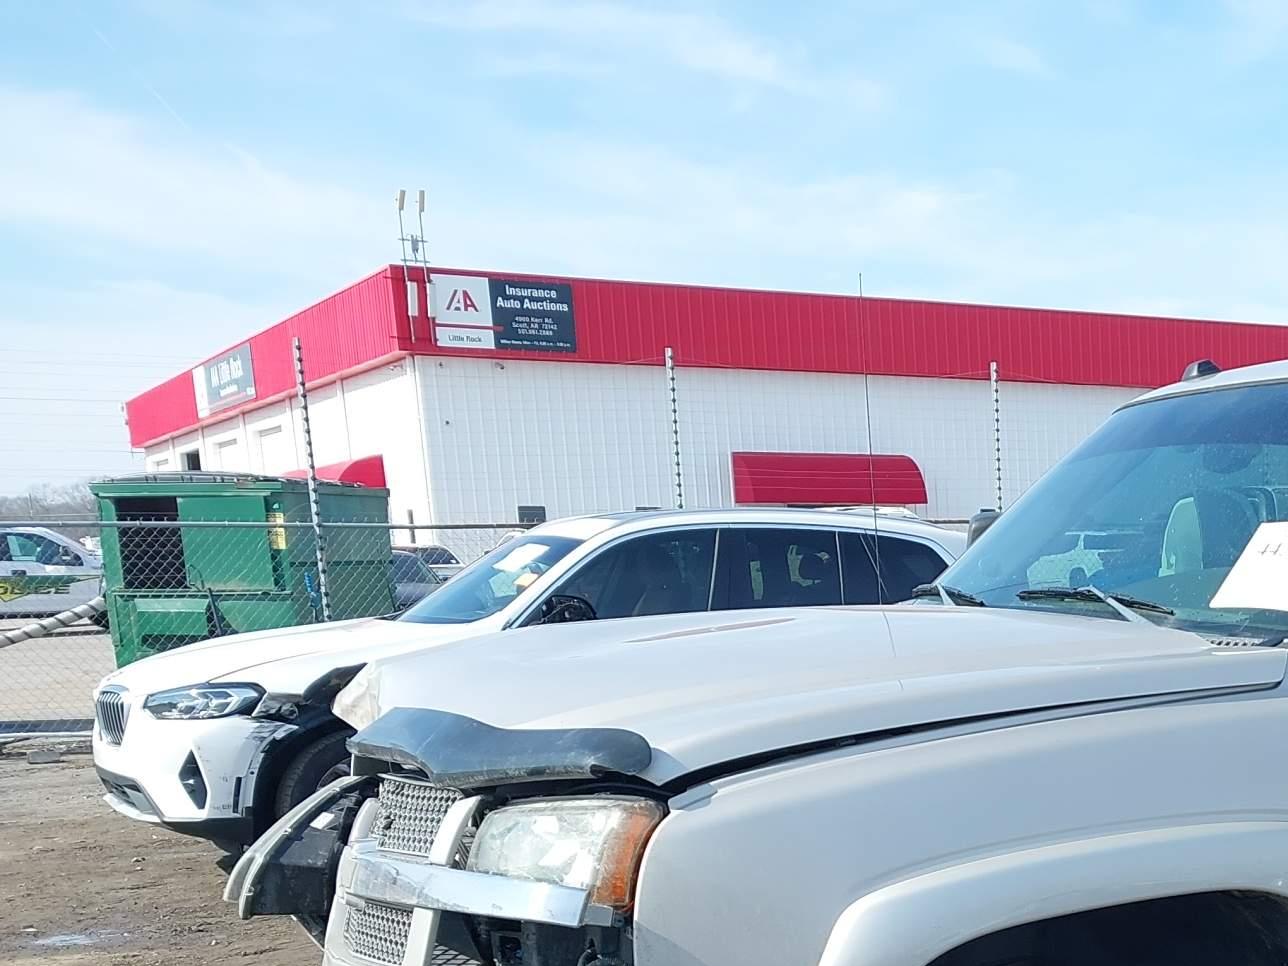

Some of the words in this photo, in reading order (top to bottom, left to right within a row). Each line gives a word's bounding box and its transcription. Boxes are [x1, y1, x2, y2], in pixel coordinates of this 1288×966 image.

[505, 284, 557, 298] Insurance
[496, 297, 521, 309] Auto
[523, 298, 569, 312] Auctions
[448, 334, 465, 342] Little
[466, 335, 482, 343] Rock
